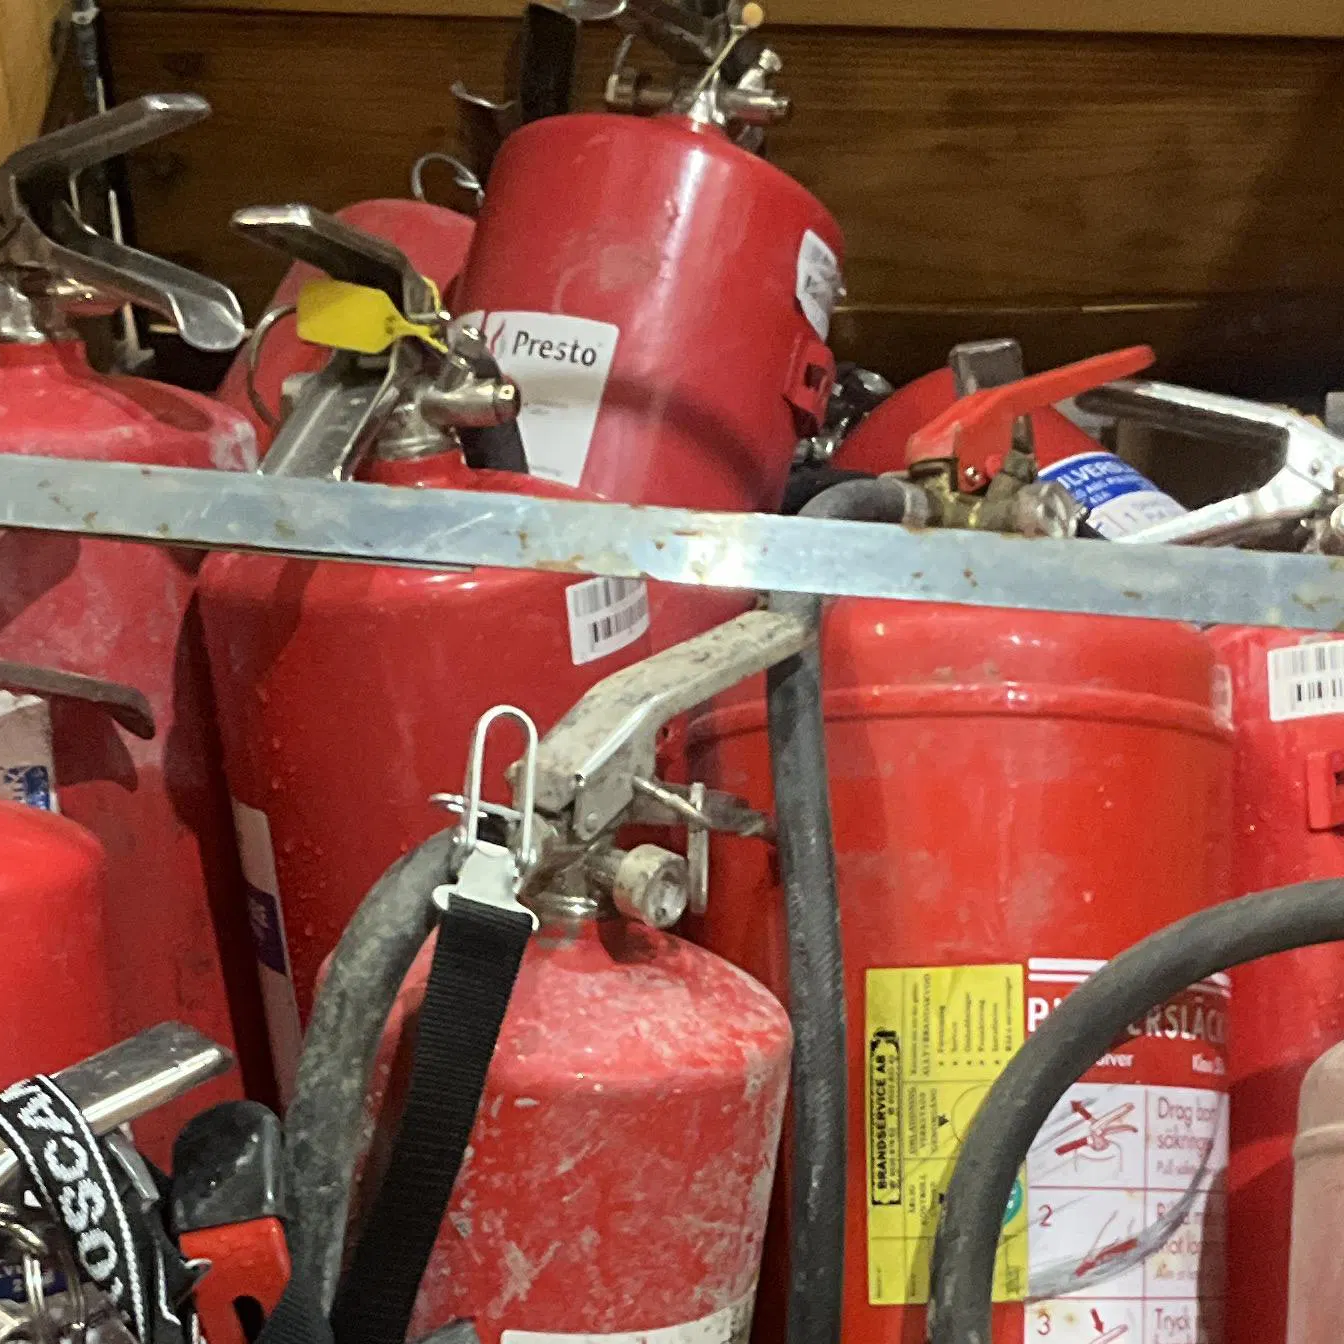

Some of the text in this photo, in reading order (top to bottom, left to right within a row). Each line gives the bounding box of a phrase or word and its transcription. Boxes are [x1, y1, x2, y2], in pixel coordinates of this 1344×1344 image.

[512, 330, 597, 366] Presto
[1039, 1204, 1053, 1228] 2
[1037, 1312, 1052, 1336] 3
